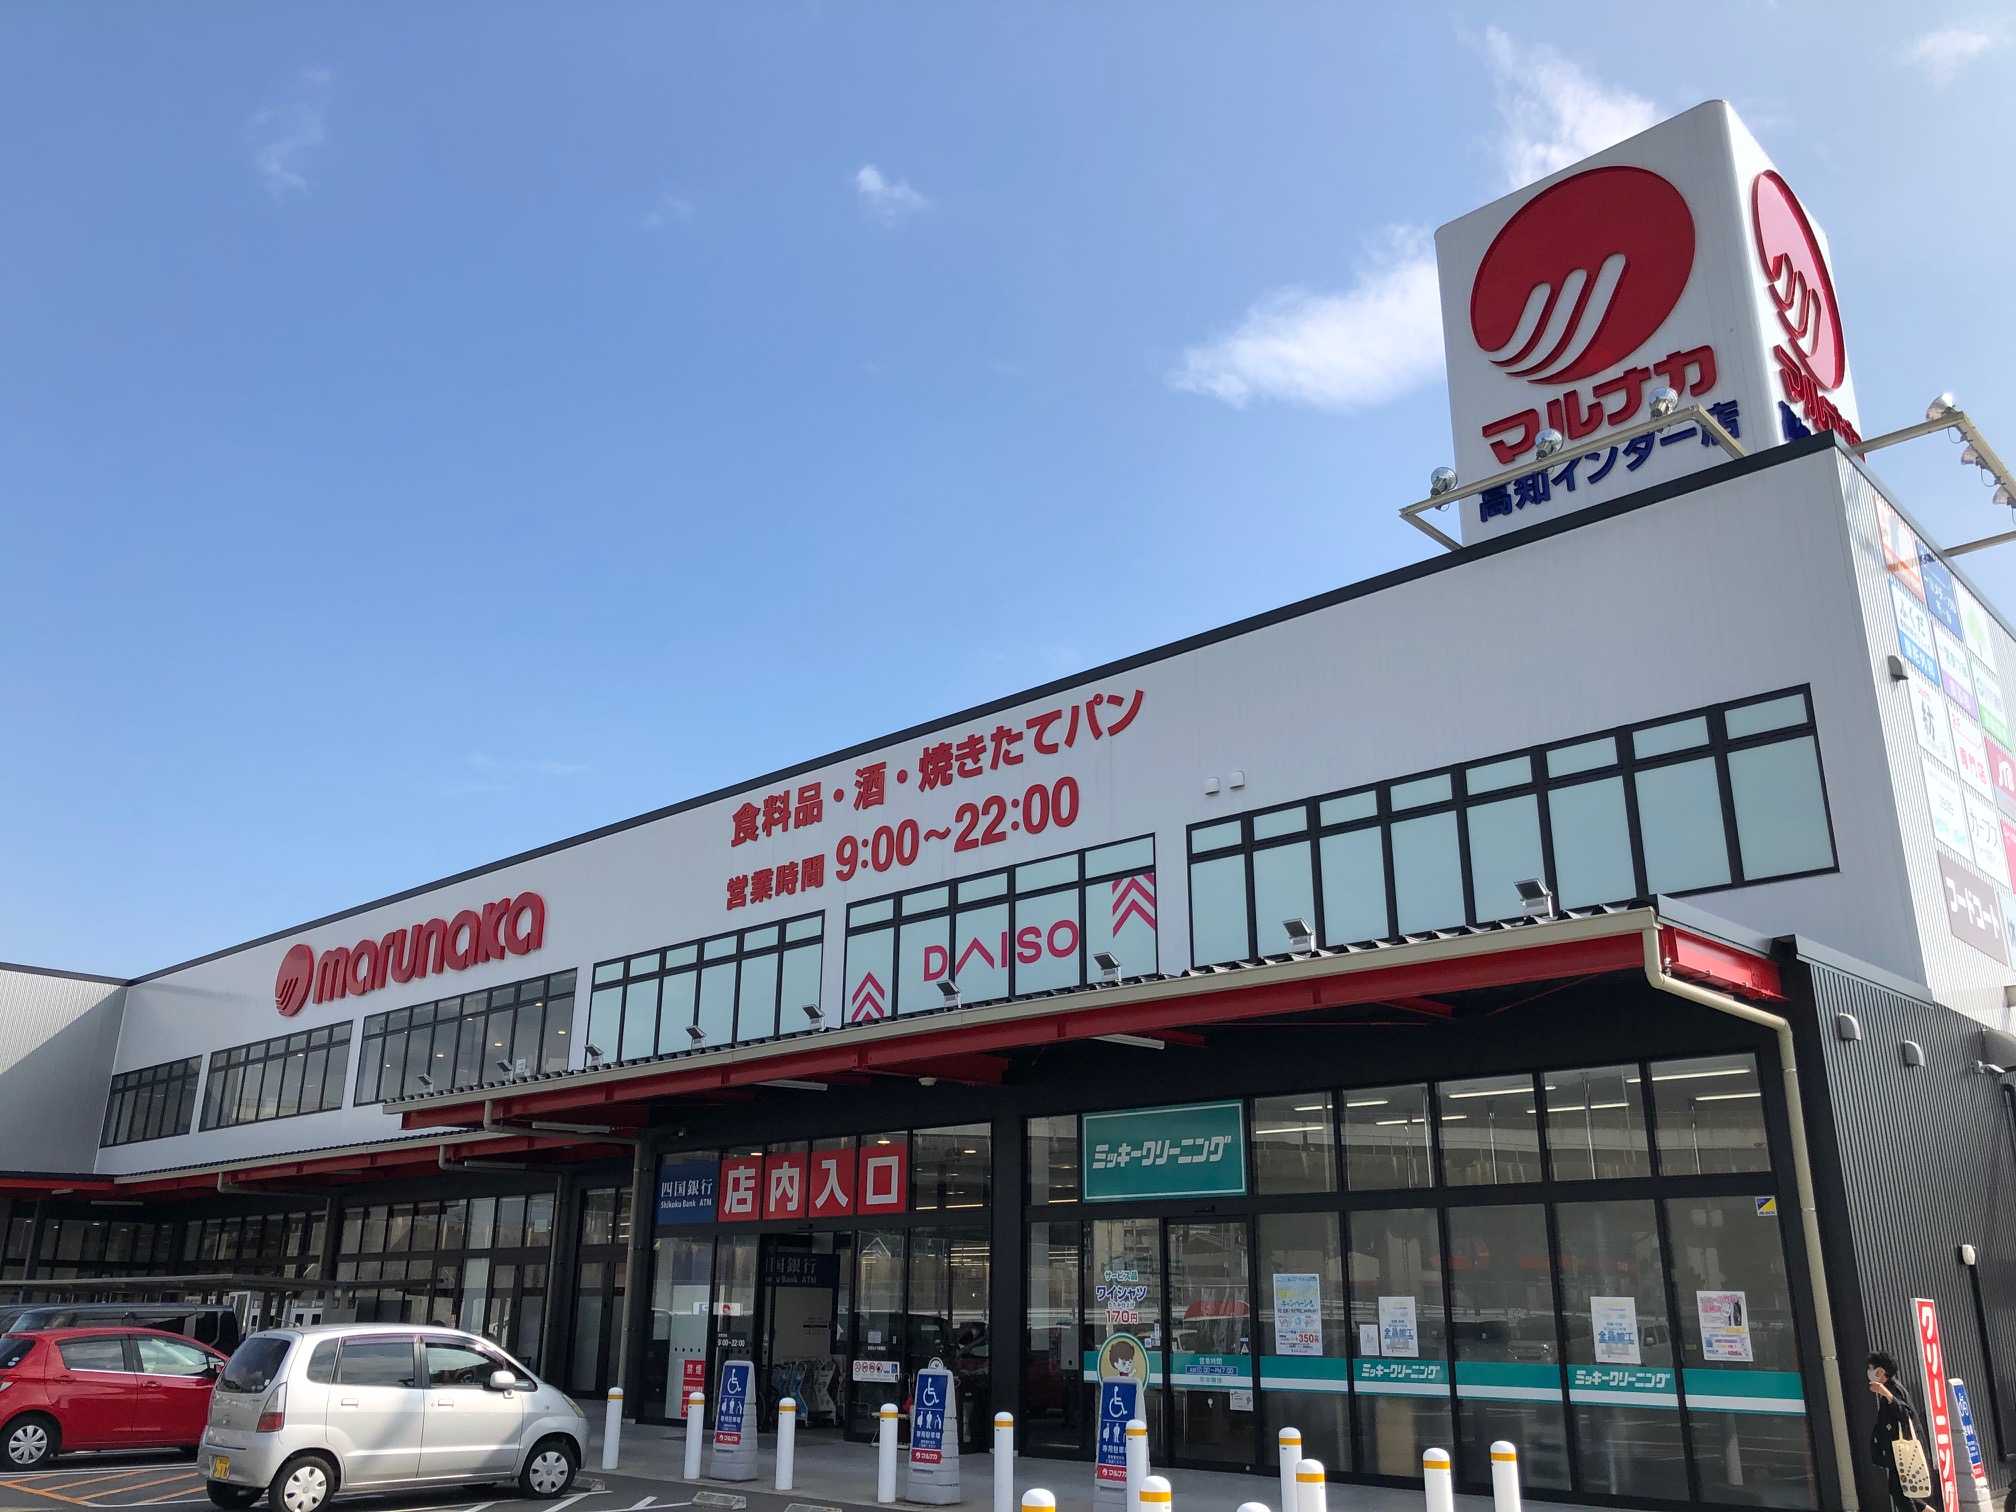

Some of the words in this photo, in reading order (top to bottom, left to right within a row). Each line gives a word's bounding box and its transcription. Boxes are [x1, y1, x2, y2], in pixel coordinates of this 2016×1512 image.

[1482, 344, 1717, 465] マルナカ
[1900, 598, 1926, 638] ふくだ
[730, 690, 1145, 848] 食料品・酒・焼きたてパン
[1959, 745, 1987, 786] 専門店
[726, 853, 825, 911] 営業時間
[1945, 876, 2000, 940] フードコート
[312, 891, 546, 1004] marunaka
[923, 919, 1080, 982] DAISO
[1092, 1135, 1232, 1169] ミッキークリーニング
[661, 1178, 714, 1198] 四国銀行
[723, 1156, 899, 1215] 店内入口
[660, 1200, 682, 1209] Shikoku
[683, 1199, 696, 1208] Bank
[699, 1198, 712, 1207] ATM
[781, 1276, 798, 1284] Bank
[802, 1276, 817, 1284] ATM
[1104, 1270, 1138, 1281] サービス品
[1096, 1285, 1147, 1301] ワイシャツ
[1105, 1309, 1138, 1324] 170円
[1199, 1357, 1223, 1366] 営業時間
[1361, 1363, 1440, 1379] ミッキークリーニング
[1199, 1376, 1222, 1384] 年中無休
[1574, 1369, 1670, 1388] ミッキークリーニング
[921, 1453, 938, 1461] マルナカ
